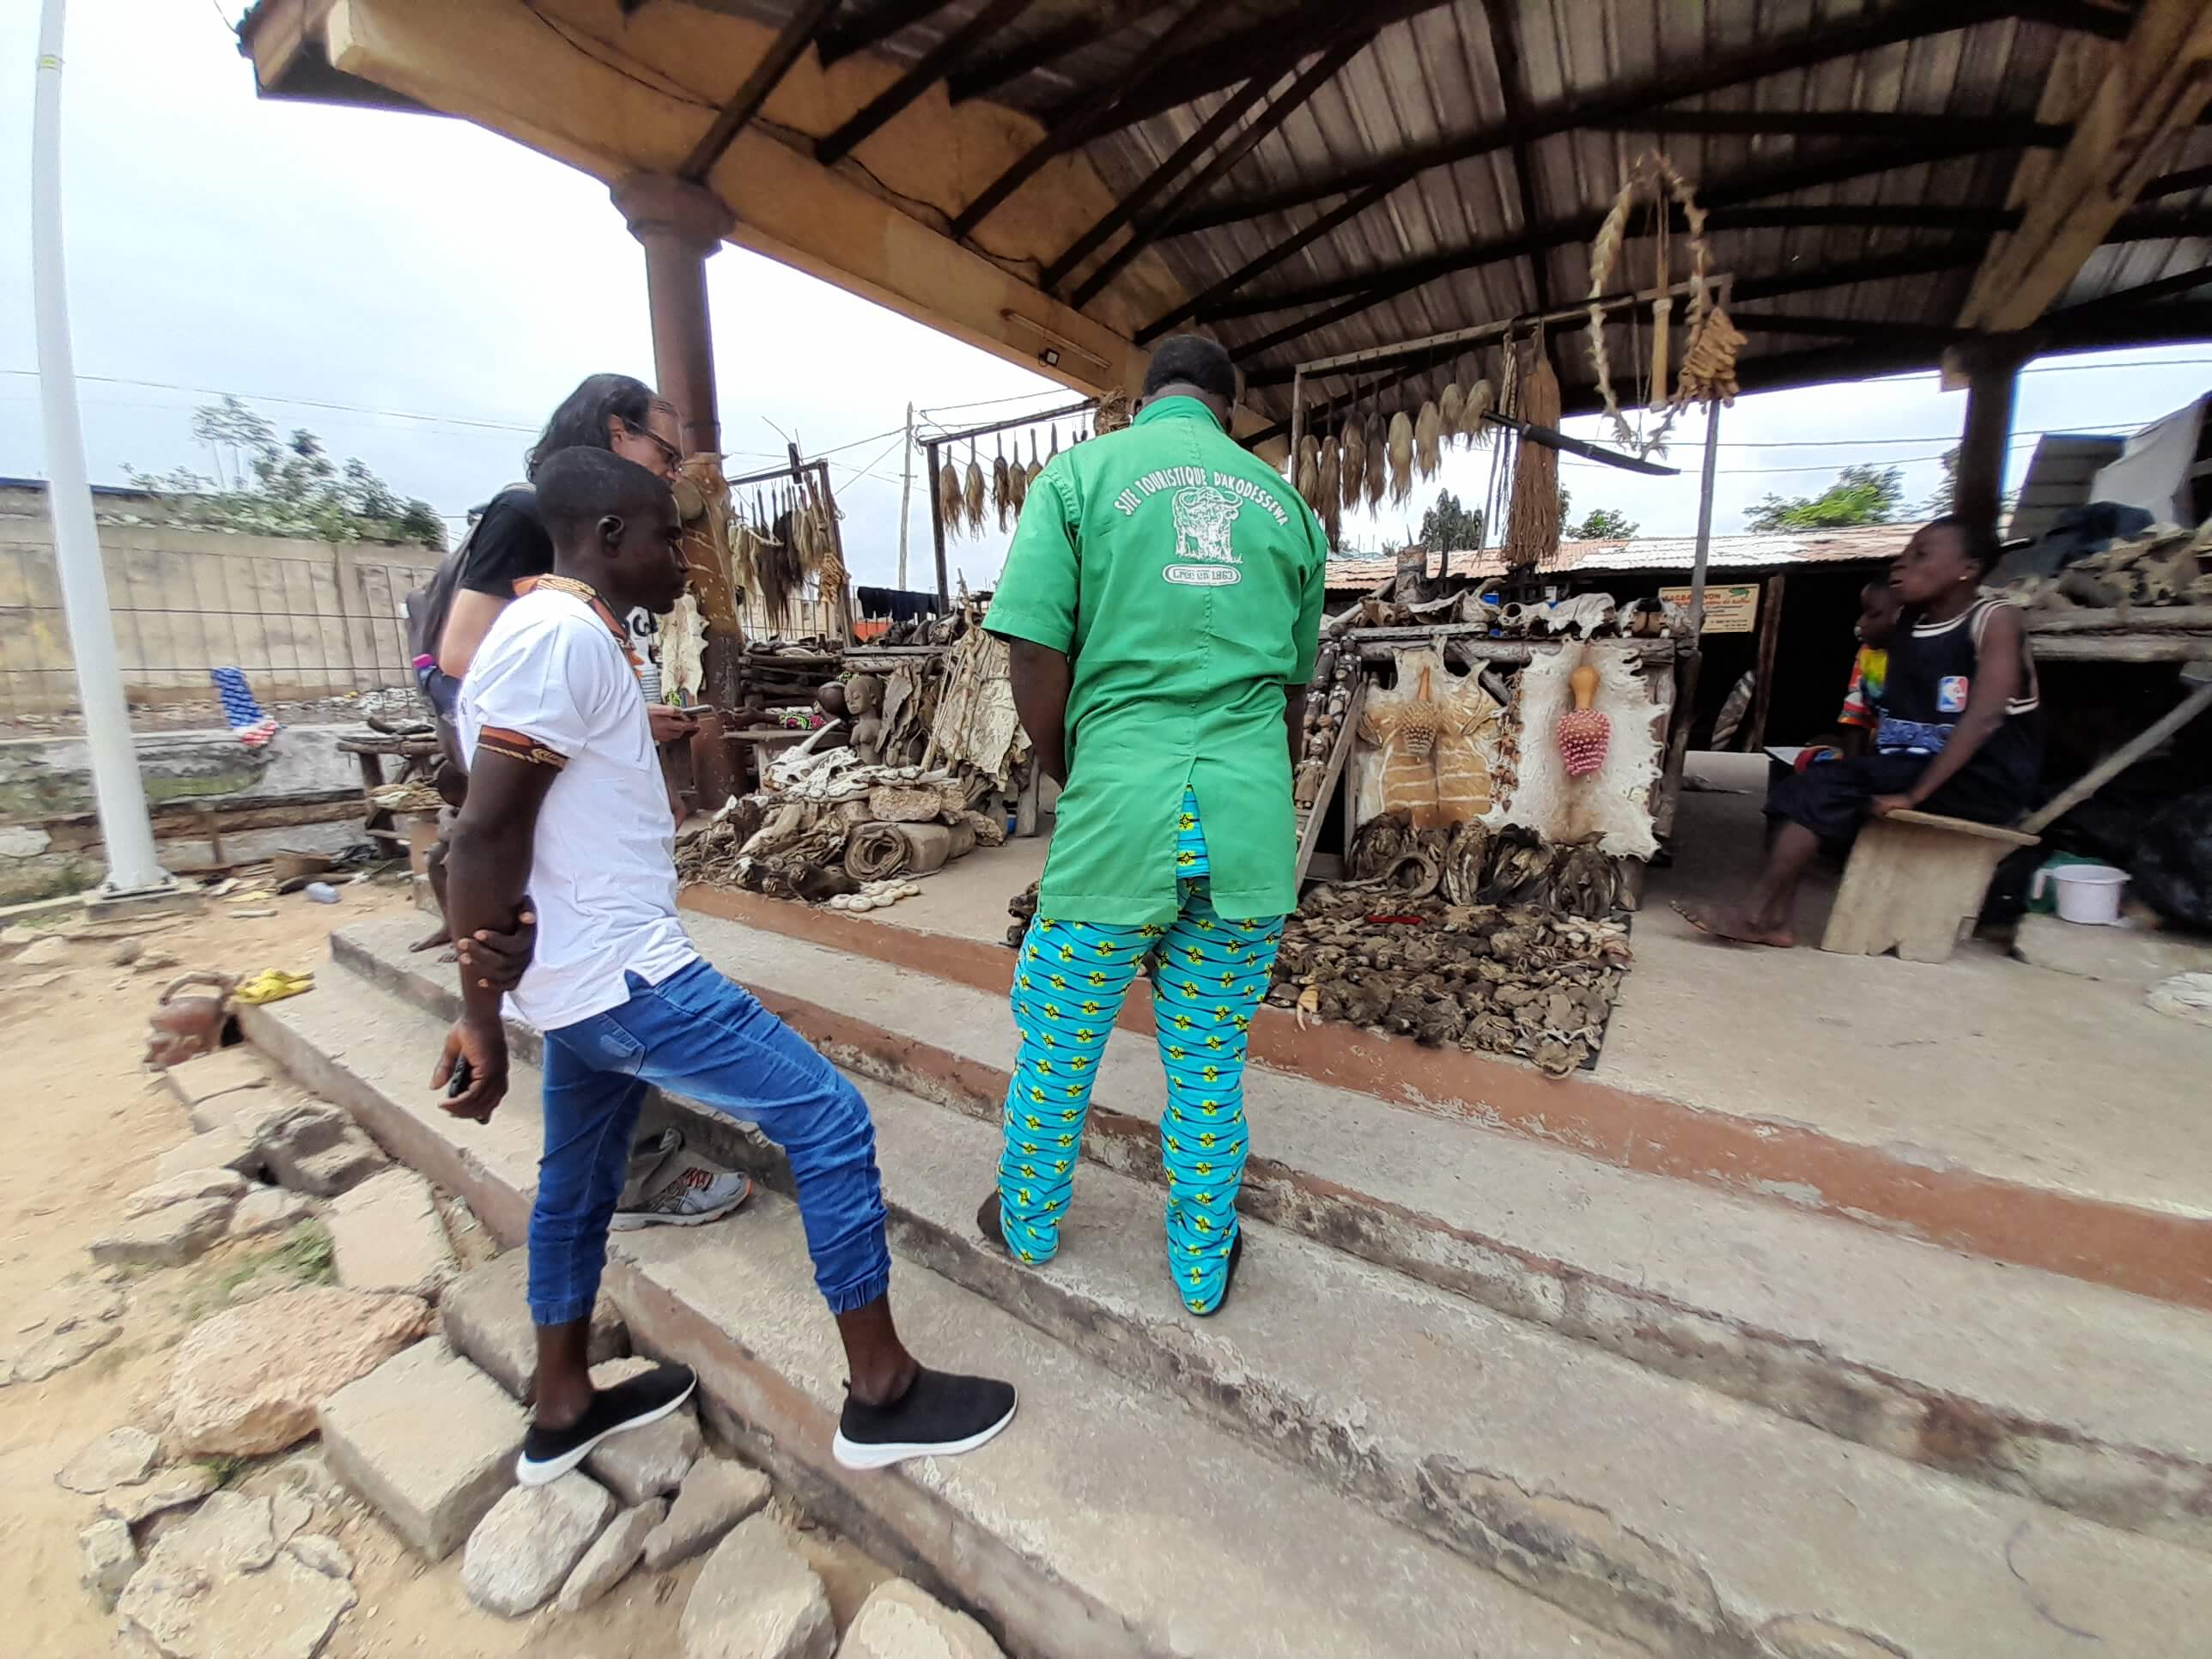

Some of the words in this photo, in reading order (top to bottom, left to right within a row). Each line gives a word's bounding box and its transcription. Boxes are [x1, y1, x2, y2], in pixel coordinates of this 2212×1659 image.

[1114, 488, 1142, 515] SITE
[1134, 466, 1207, 496] TOURISTIQUE
[1213, 471, 1288, 526] D'AKODESSEWA
[1212, 570, 1234, 580] 1863
